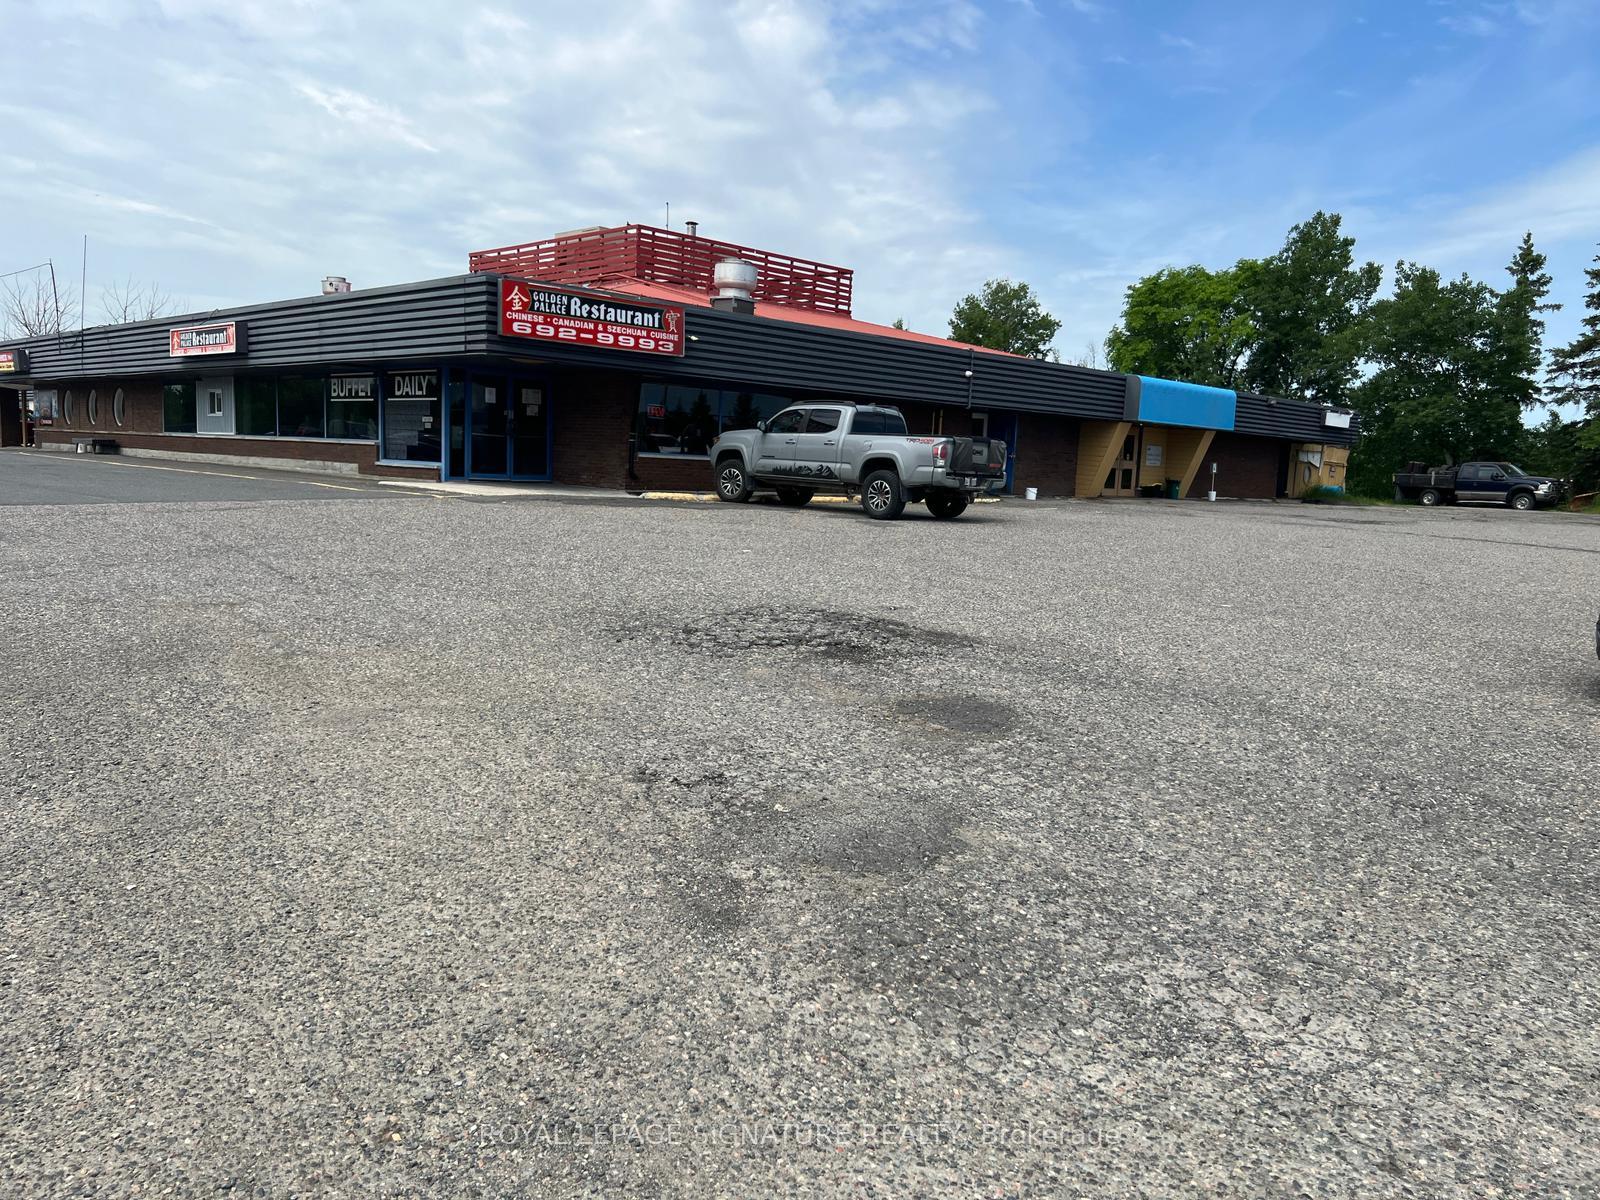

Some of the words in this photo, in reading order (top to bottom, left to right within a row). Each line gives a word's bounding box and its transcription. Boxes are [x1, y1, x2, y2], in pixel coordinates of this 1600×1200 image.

[505, 285, 530, 311] 金
[533, 291, 568, 306] GOLDEN
[534, 301, 567, 315] PALACE
[570, 297, 660, 328] Restaurant
[192, 330, 227, 347] Restaurant
[506, 311, 545, 323] CHINESE
[552, 317, 595, 330] CANADIAN
[597, 323, 604, 331] &
[607, 325, 647, 337] SZECHUAN
[650, 331, 679, 342] CUISINE
[512, 321, 674, 352] 692-9993
[331, 378, 373, 397] BUFFET
[395, 375, 429, 396] DAILY
